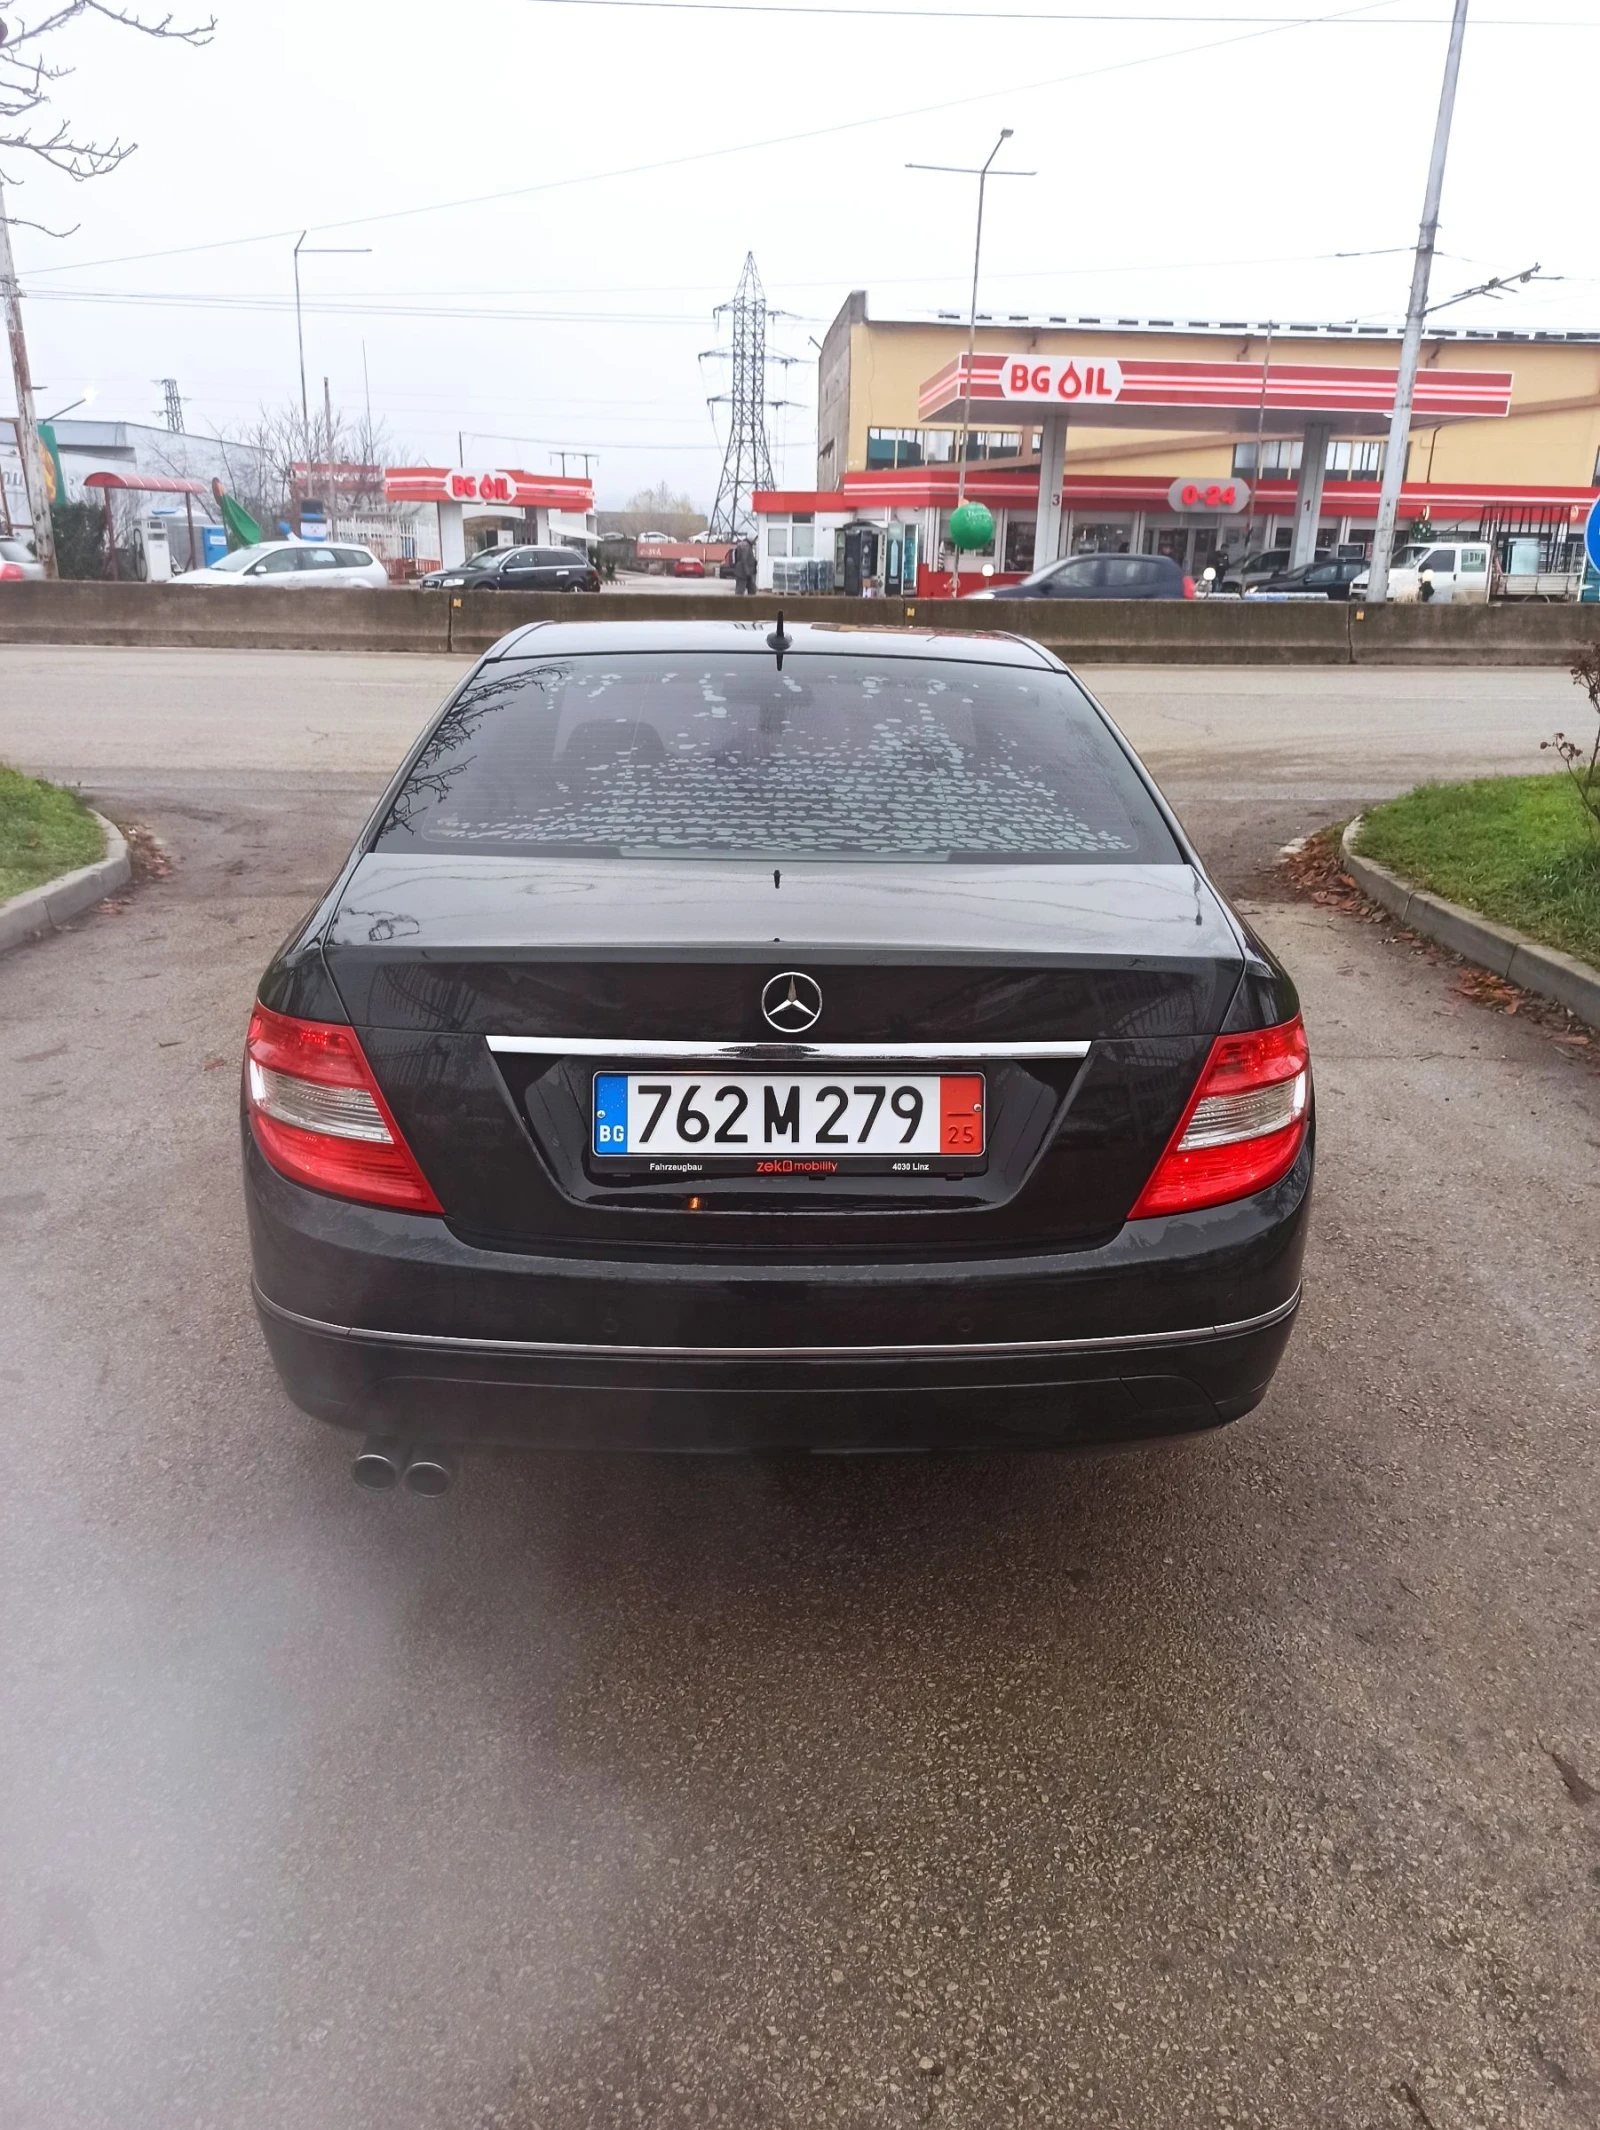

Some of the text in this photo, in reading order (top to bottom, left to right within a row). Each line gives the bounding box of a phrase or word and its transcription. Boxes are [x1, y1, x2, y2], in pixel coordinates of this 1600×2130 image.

[1010, 360, 1113, 399] BG OIL
[452, 473, 512, 500] BG OIL
[1051, 494, 1061, 506] 3
[1181, 485, 1236, 507] 0-24
[1303, 499, 1311, 512] 1
[638, 1085, 924, 1143] 762 M 279
[599, 1124, 625, 1142] BG
[947, 1125, 975, 1144] 25
[649, 1162, 703, 1173] Fahrzeugbau
[892, 1162, 930, 1171] 4030 Linz
